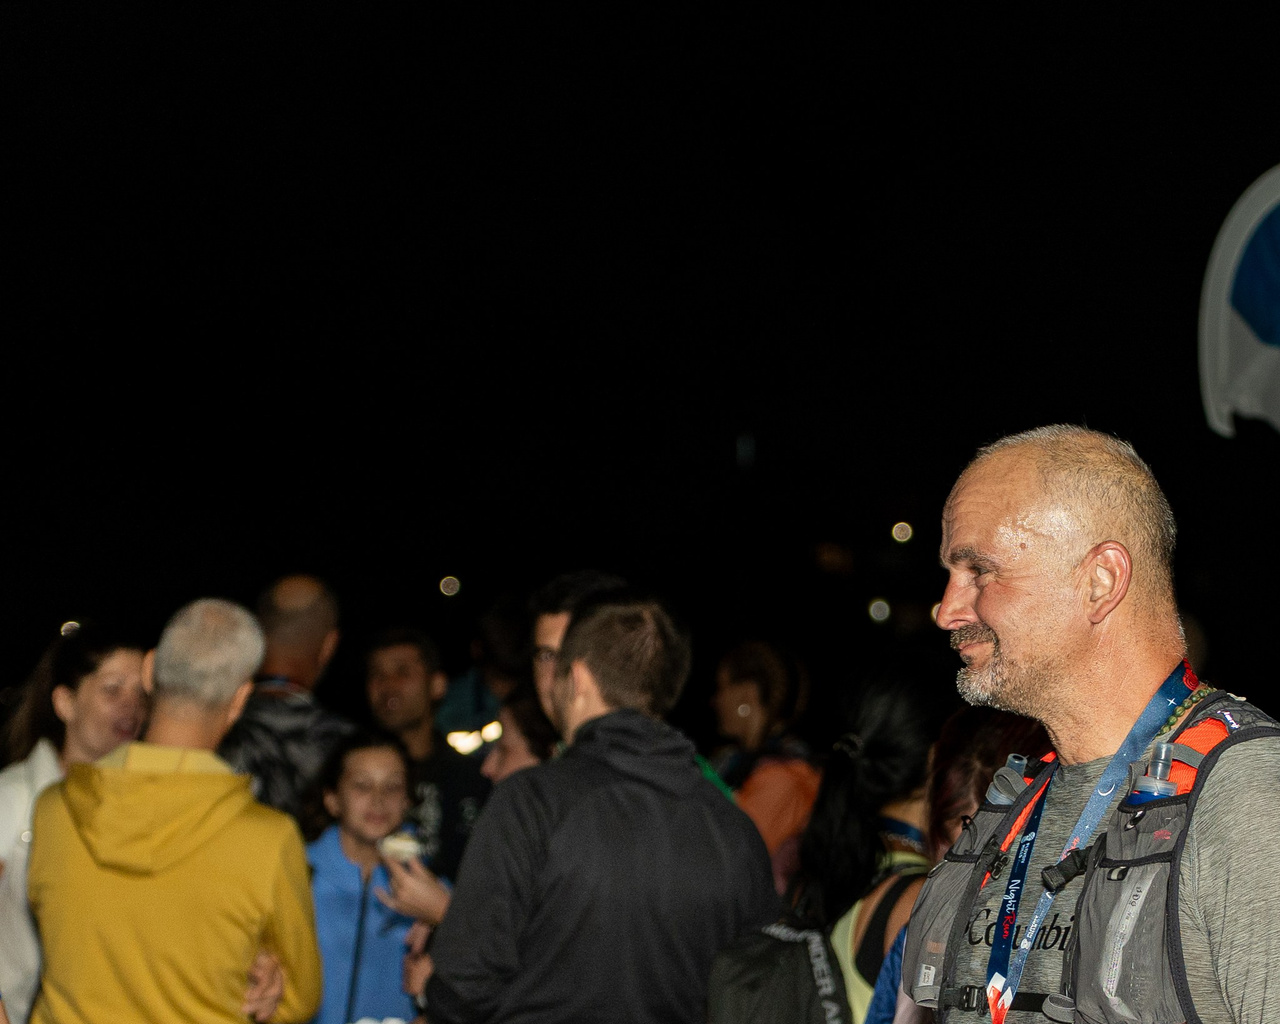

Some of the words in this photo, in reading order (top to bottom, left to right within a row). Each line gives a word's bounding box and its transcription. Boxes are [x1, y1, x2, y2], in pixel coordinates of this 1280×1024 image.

[1004, 879, 1021, 914] Night
[968, 908, 1076, 951] Coumbi
[1002, 911, 1016, 939] Run
